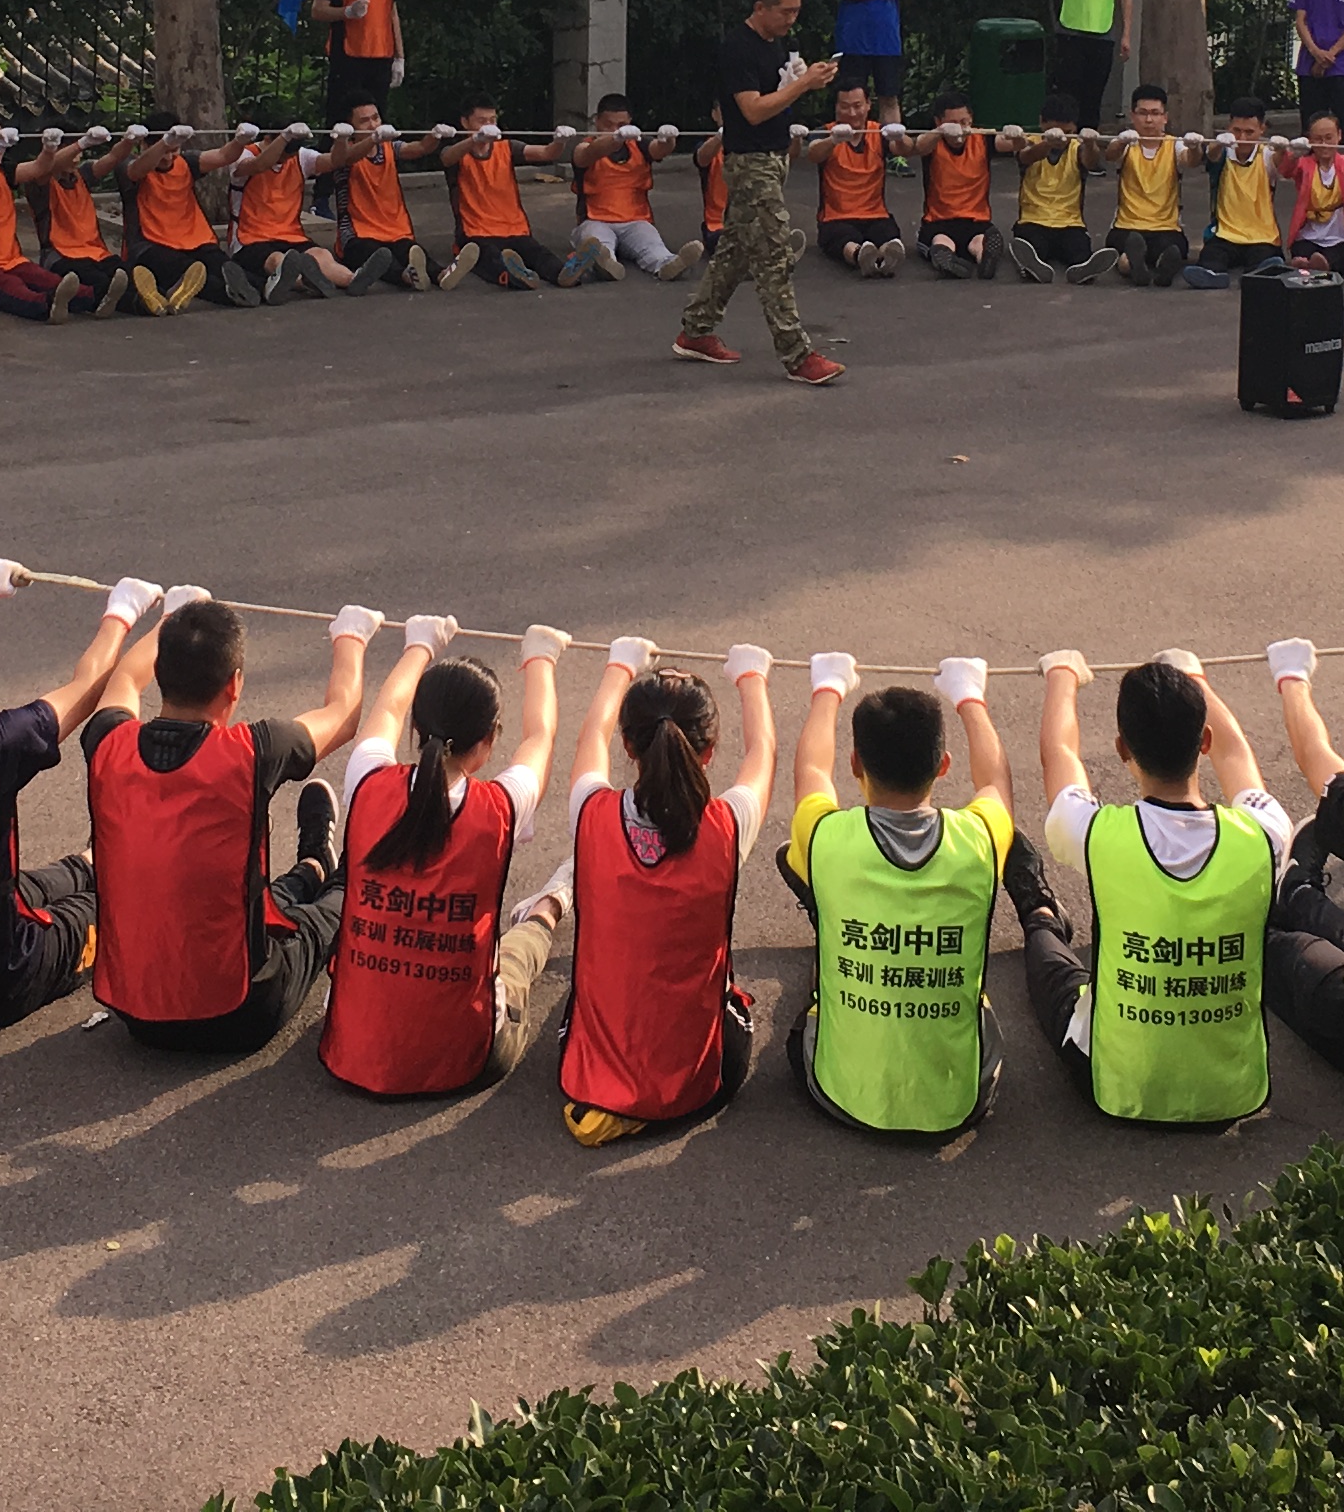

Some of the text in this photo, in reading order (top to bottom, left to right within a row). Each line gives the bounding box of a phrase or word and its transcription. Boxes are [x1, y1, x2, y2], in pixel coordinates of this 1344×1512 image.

[359, 879, 477, 922] 亮剑中国
[351, 915, 477, 952] 军训 拓展训练
[841, 918, 964, 956] 亮剑中国
[1122, 931, 1245, 967] 亮剑中国
[350, 949, 472, 982] 15069130959
[837, 955, 966, 989] 军训 拓展训练
[1116, 968, 1247, 998] 军训 拓展训练
[839, 990, 961, 1019] 15069130959
[1117, 1001, 1243, 1026] 15069130959
